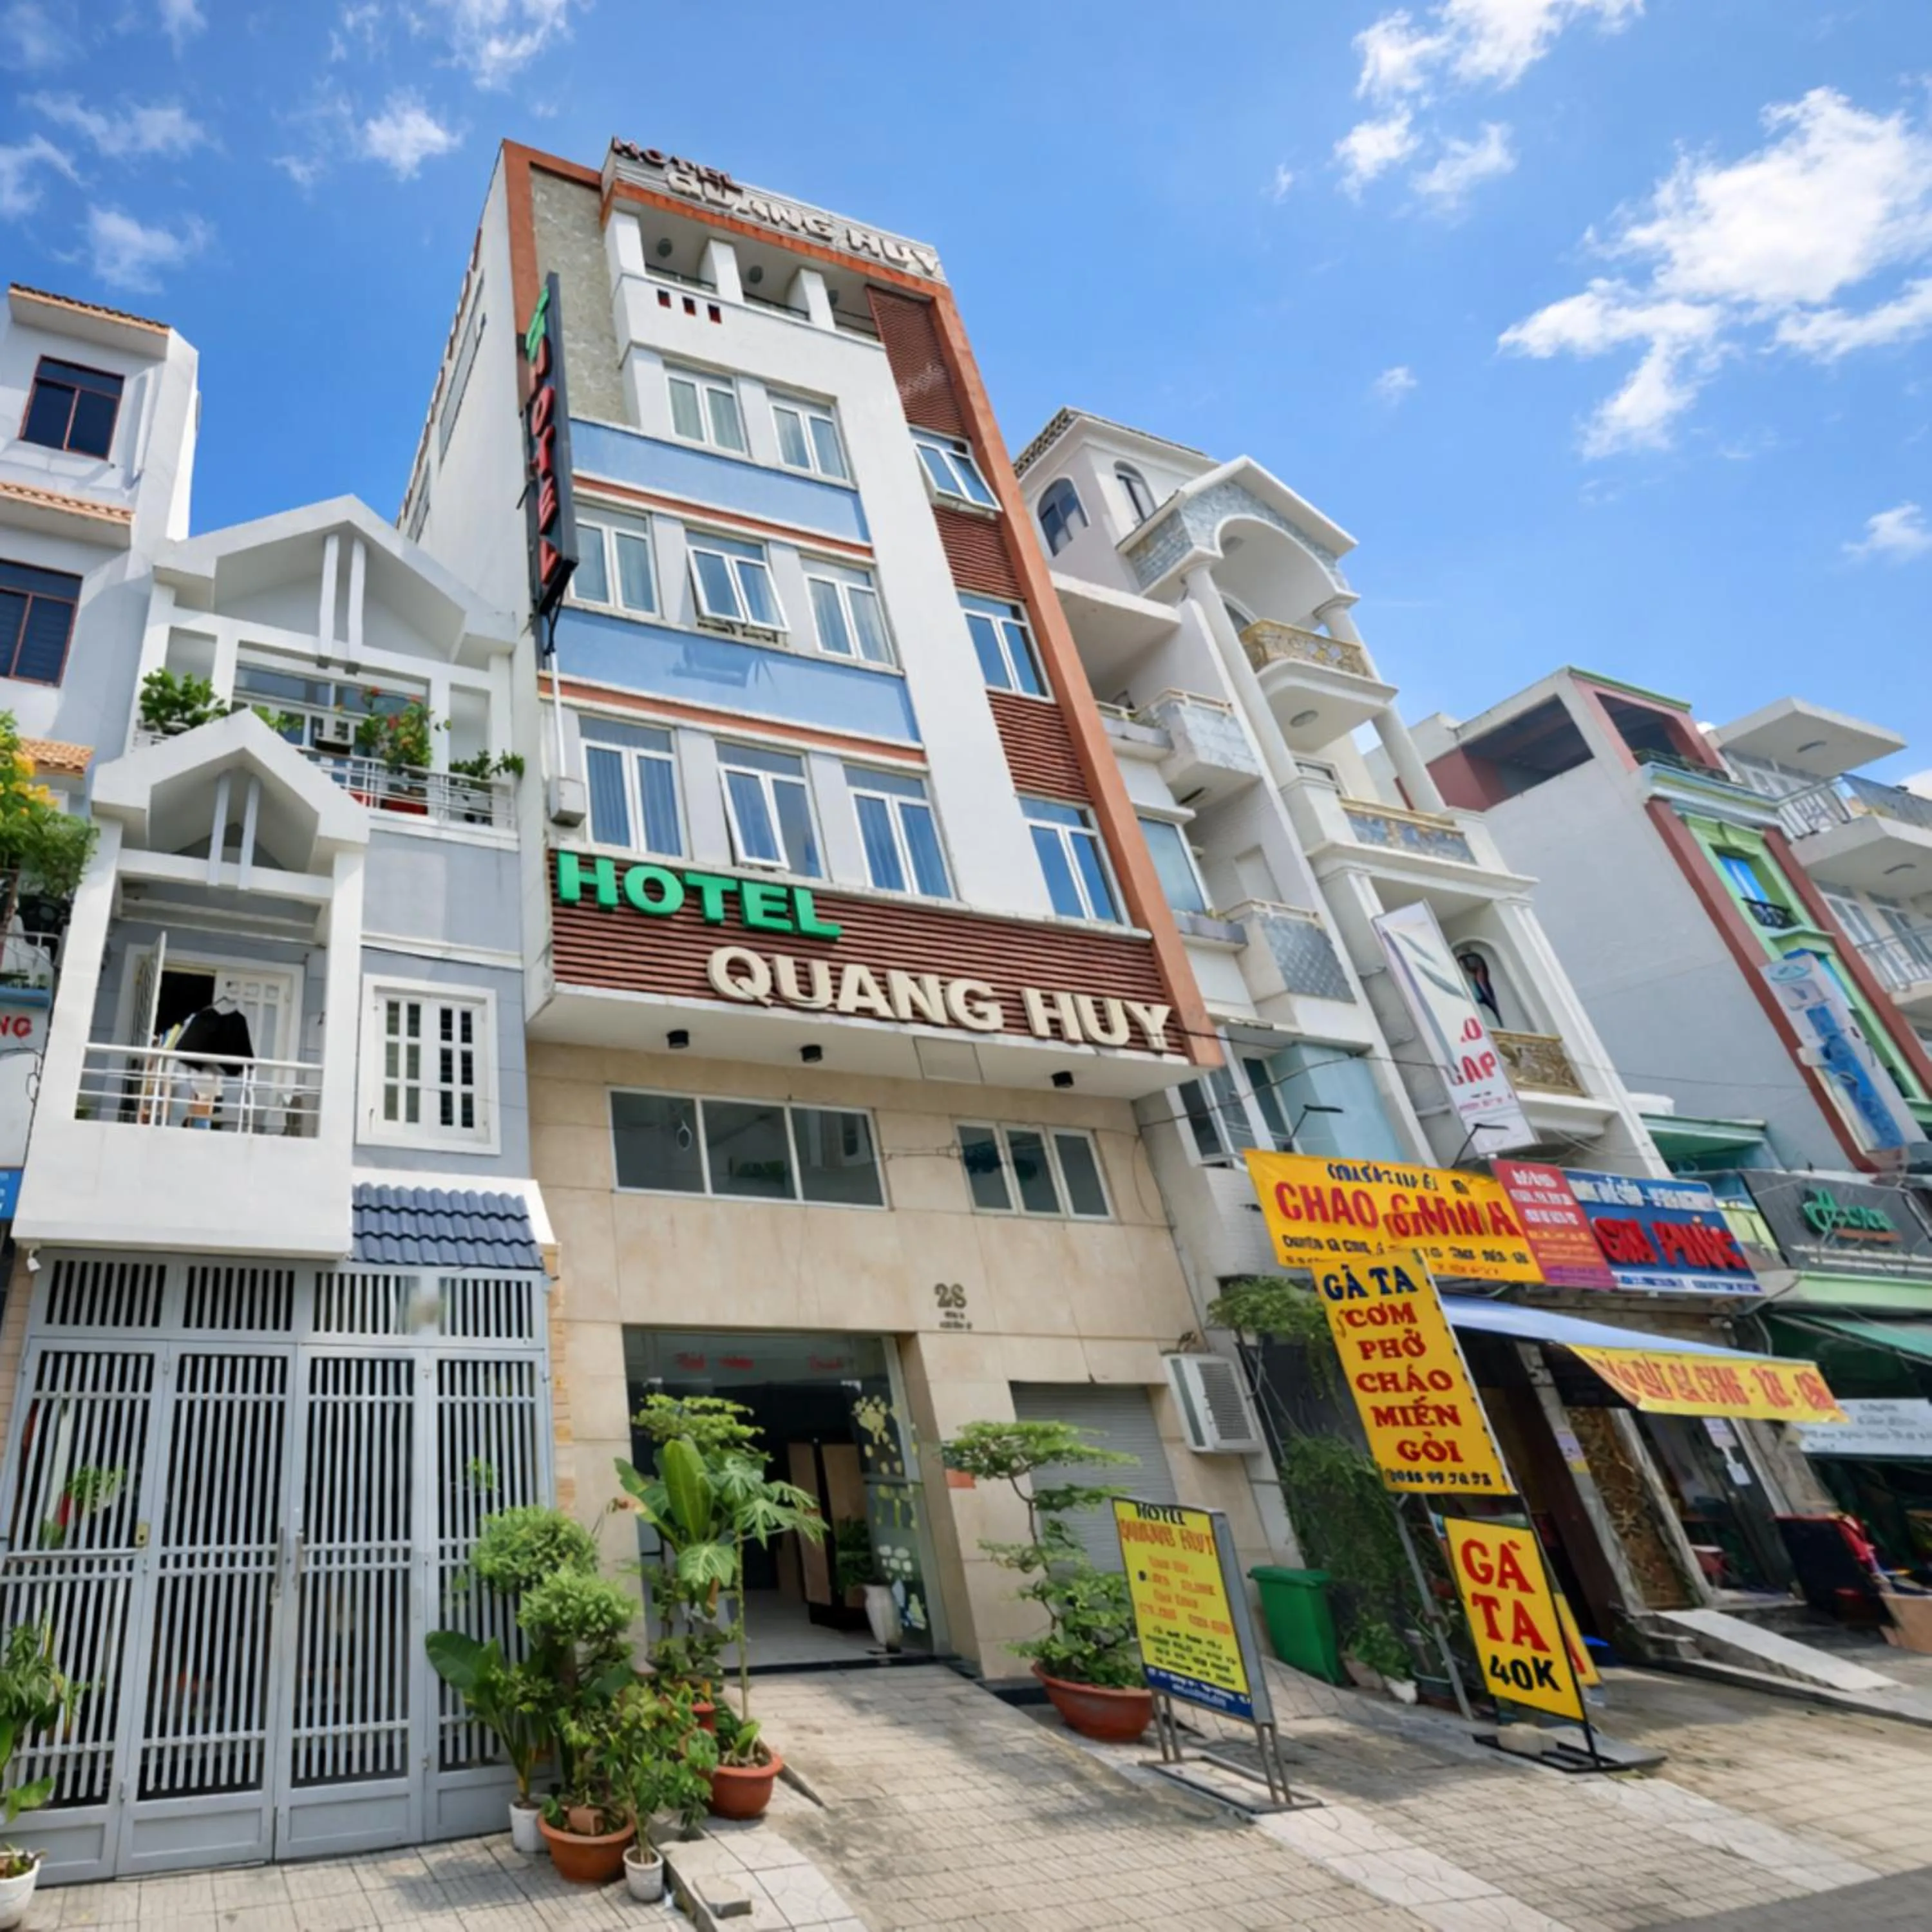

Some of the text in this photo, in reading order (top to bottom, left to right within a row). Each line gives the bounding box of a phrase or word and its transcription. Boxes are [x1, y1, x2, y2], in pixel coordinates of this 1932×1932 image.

[667, 171, 941, 277] QUANG HUY
[556, 850, 843, 942] HOTEL
[707, 946, 1173, 1051] QUANG HUY
[1323, 1263, 1419, 1300] GÀ TA
[1345, 1301, 1419, 1328] CƠM
[1356, 1363, 1454, 1394] CHÁO
[1370, 1395, 1463, 1428] MIẾN
[1460, 1538, 1536, 1595] GÀ
[1471, 1593, 1551, 1653] TA
[1490, 1654, 1562, 1693] 40K
